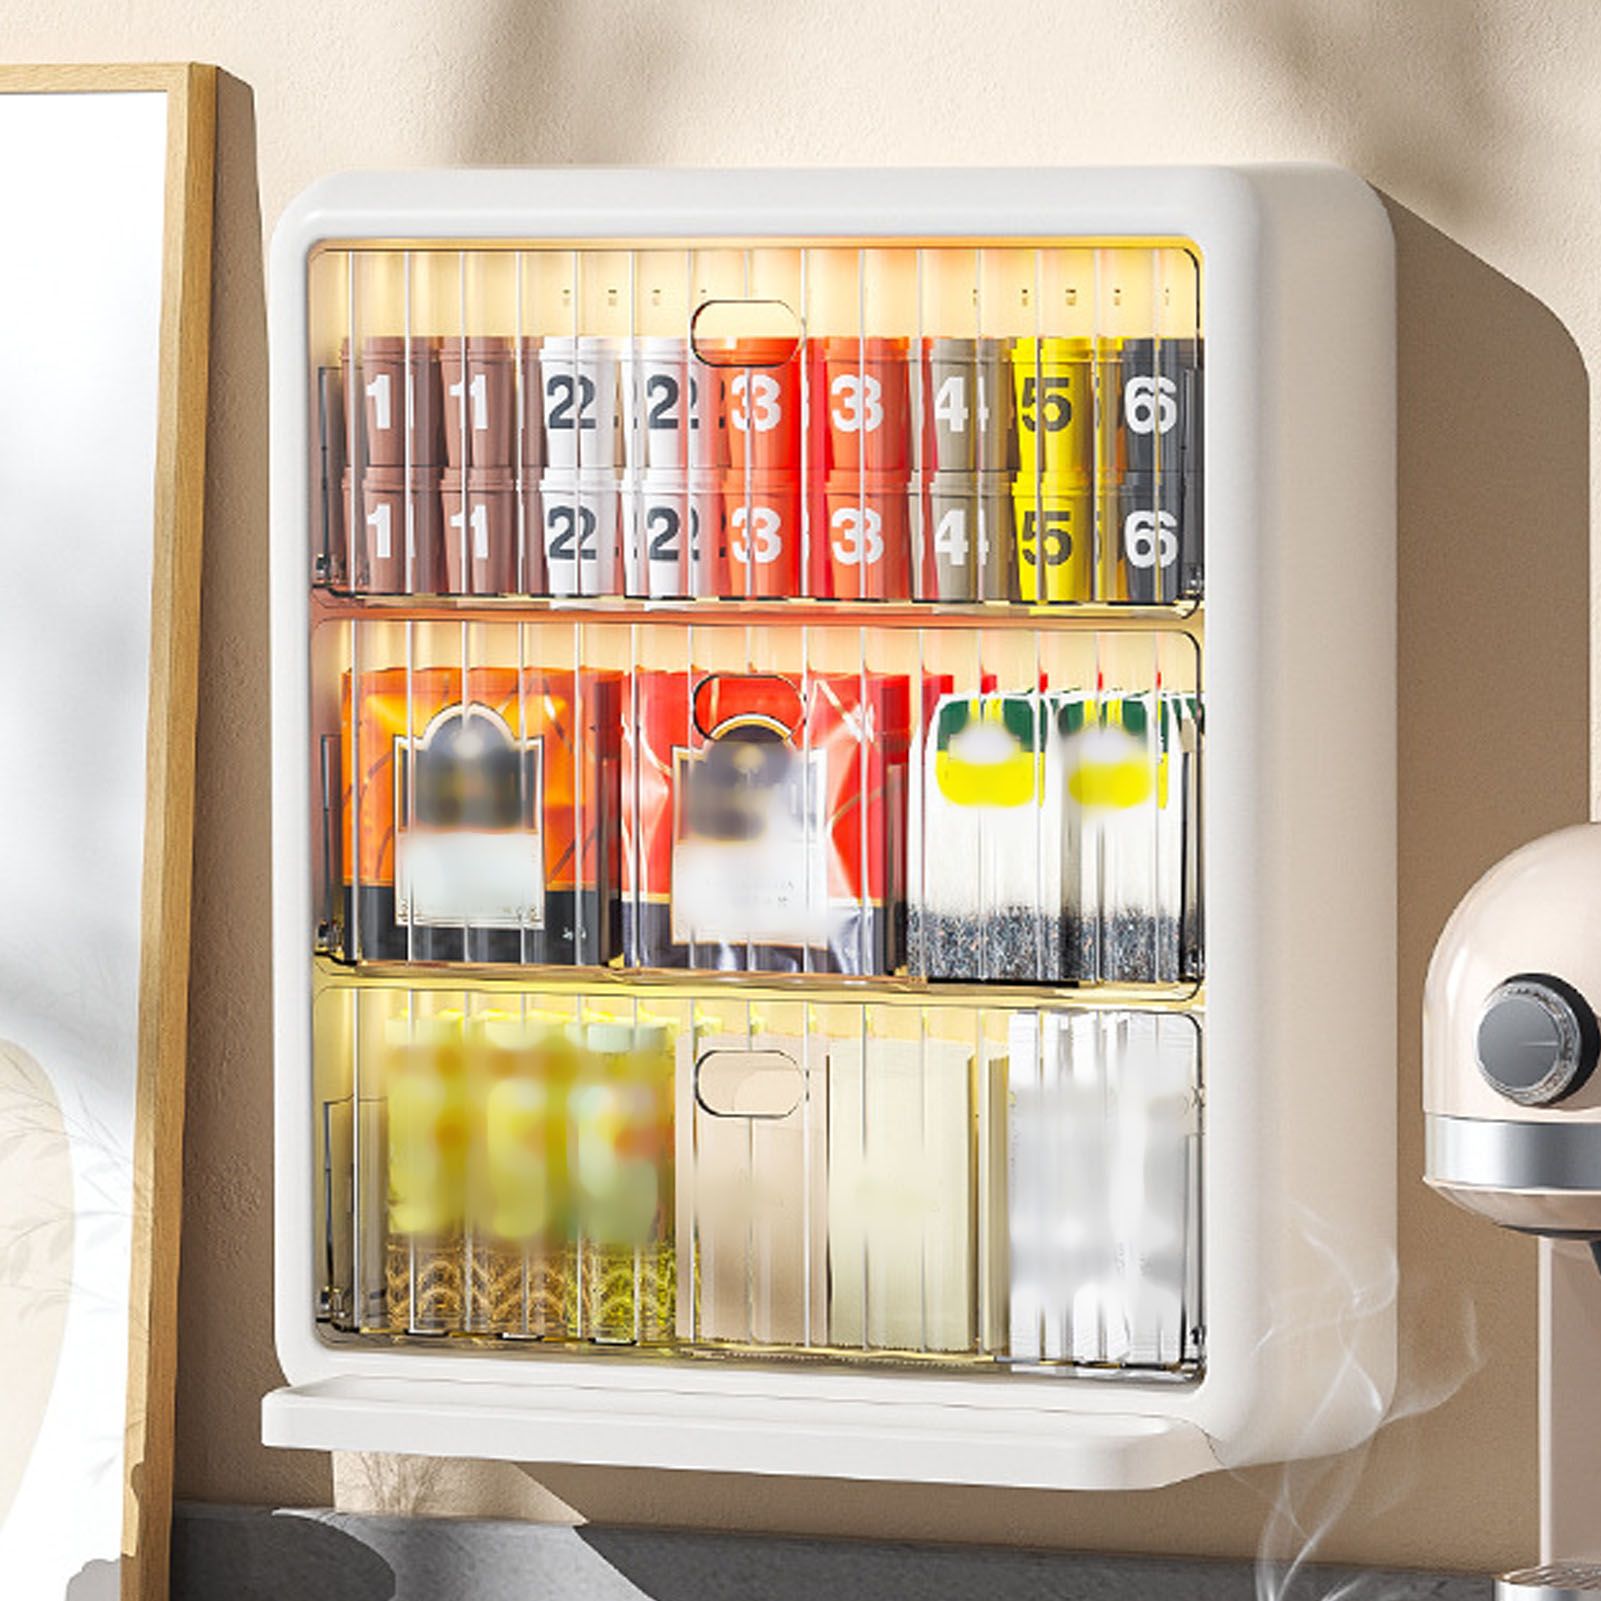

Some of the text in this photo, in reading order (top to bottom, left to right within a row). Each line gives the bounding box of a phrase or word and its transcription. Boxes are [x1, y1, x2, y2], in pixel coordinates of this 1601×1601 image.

[367, 374, 391, 429] 1
[731, 375, 781, 432] 3
[831, 375, 883, 432] 3
[1023, 378, 1073, 432] 5
[1124, 377, 1178, 434] 6
[367, 504, 391, 559] 1
[731, 507, 782, 564] 3
[832, 507, 884, 565] 3
[1023, 511, 1073, 565] 5
[1124, 510, 1179, 568] 6
